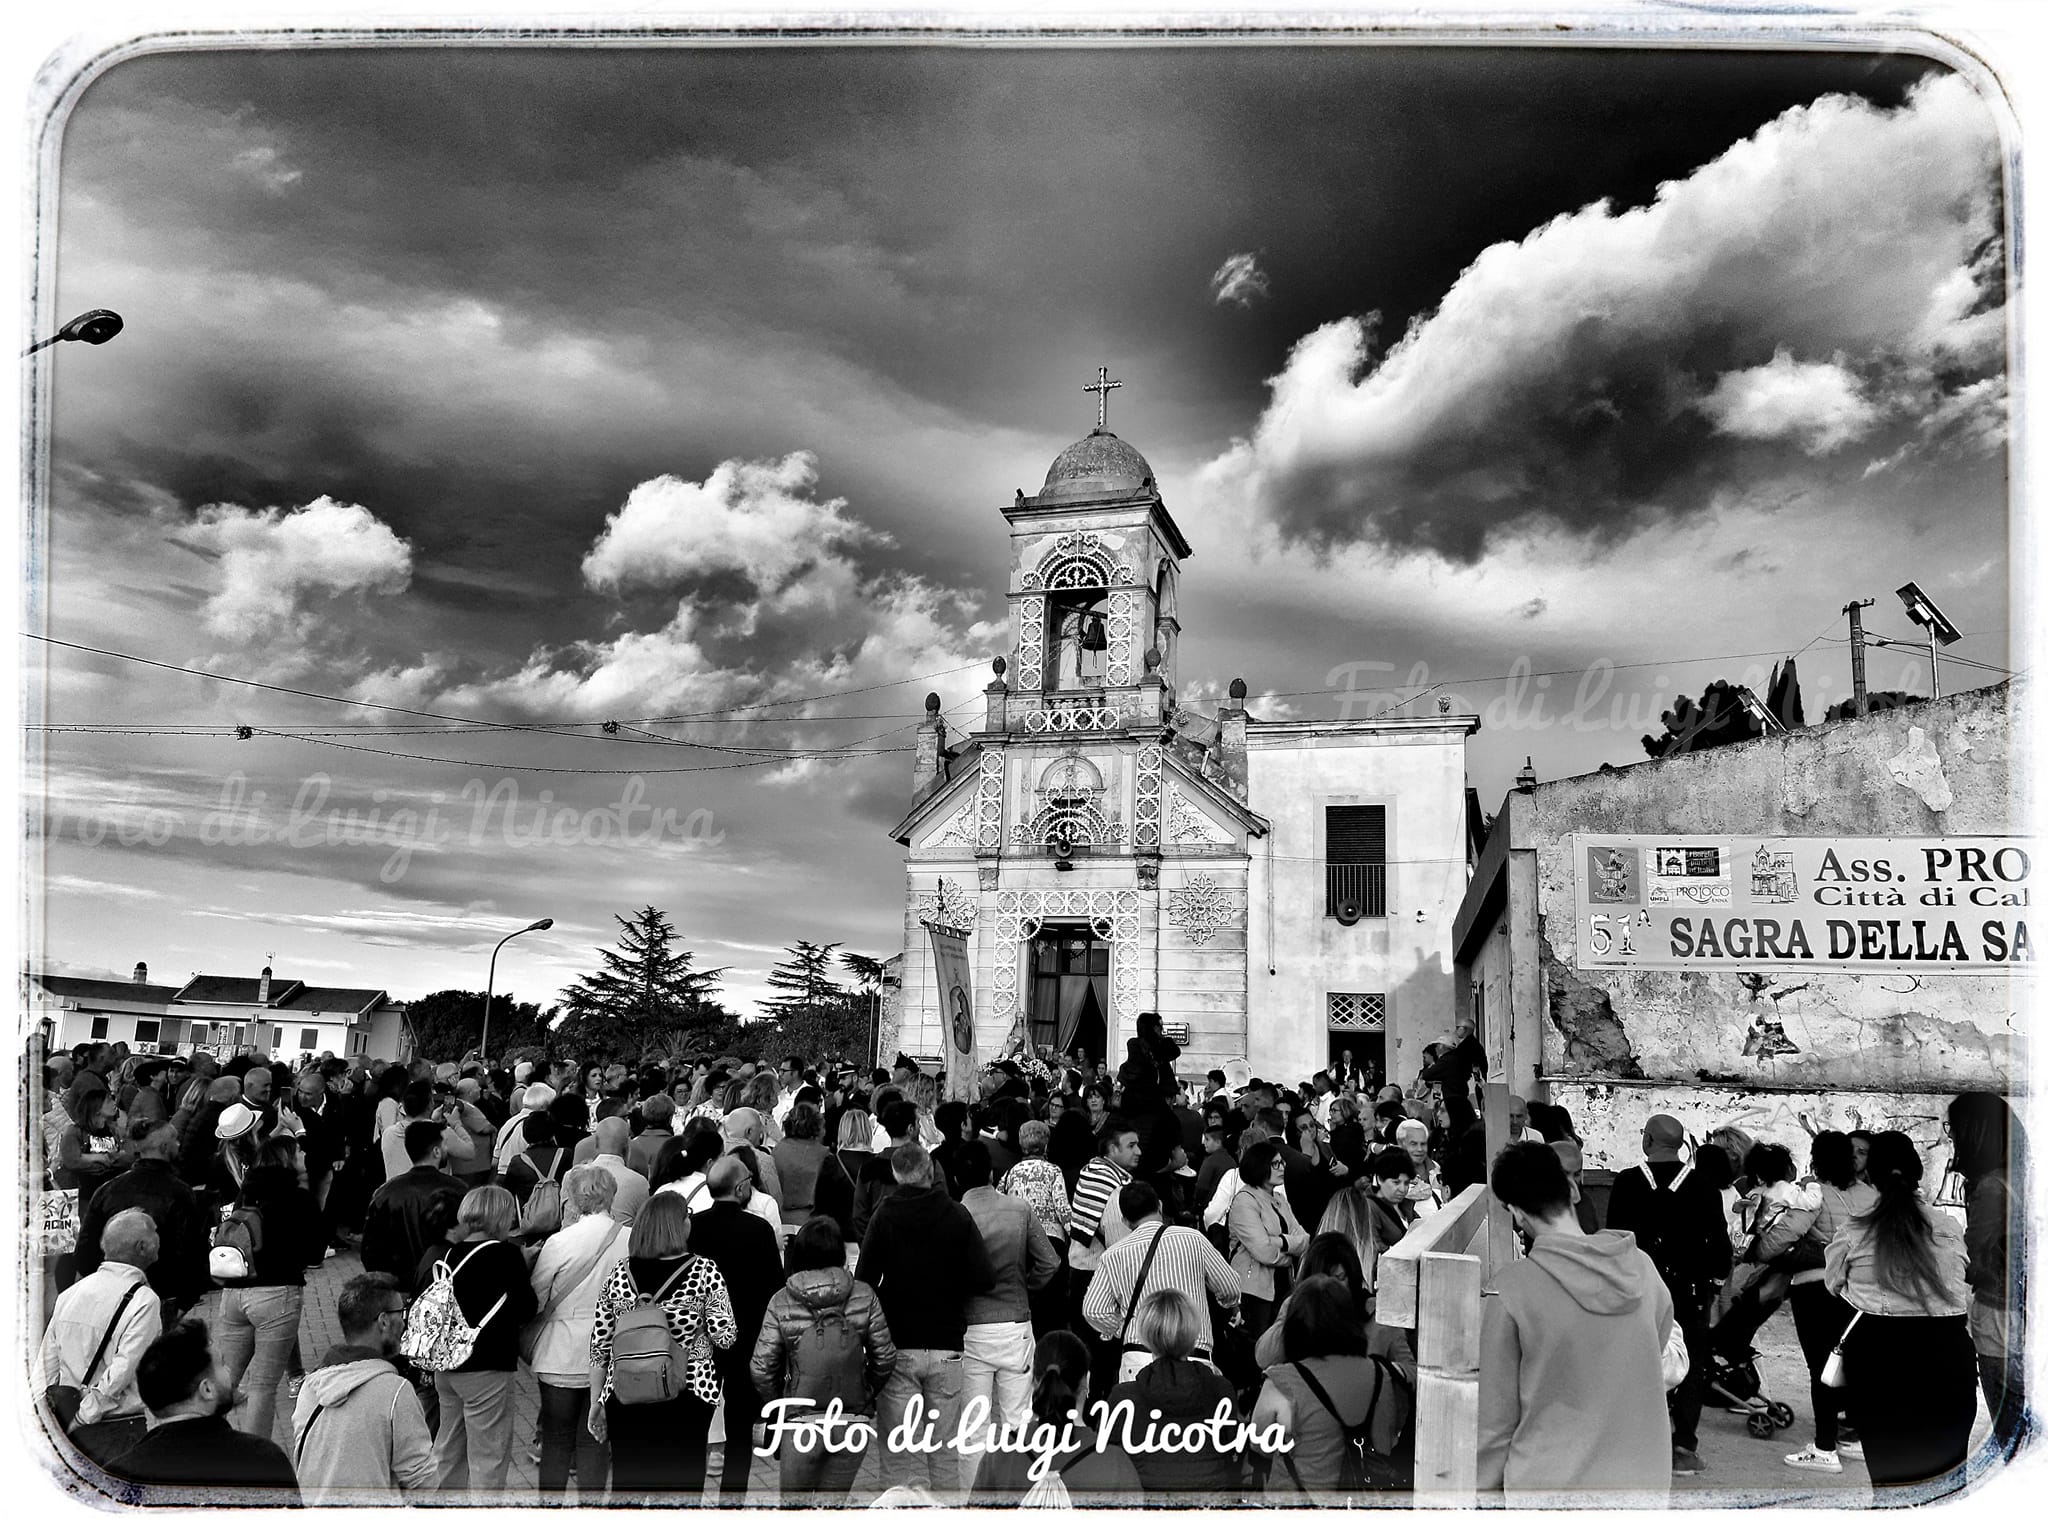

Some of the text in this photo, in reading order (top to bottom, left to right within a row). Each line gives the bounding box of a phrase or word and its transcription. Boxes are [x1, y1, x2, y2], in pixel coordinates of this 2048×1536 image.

[1813, 847, 2032, 883] Ass. PRO
[1813, 886, 1907, 907] Città
[1919, 887, 1957, 907] di
[1670, 917, 1815, 959] SAGRA
[1826, 919, 1970, 961] DELLA
